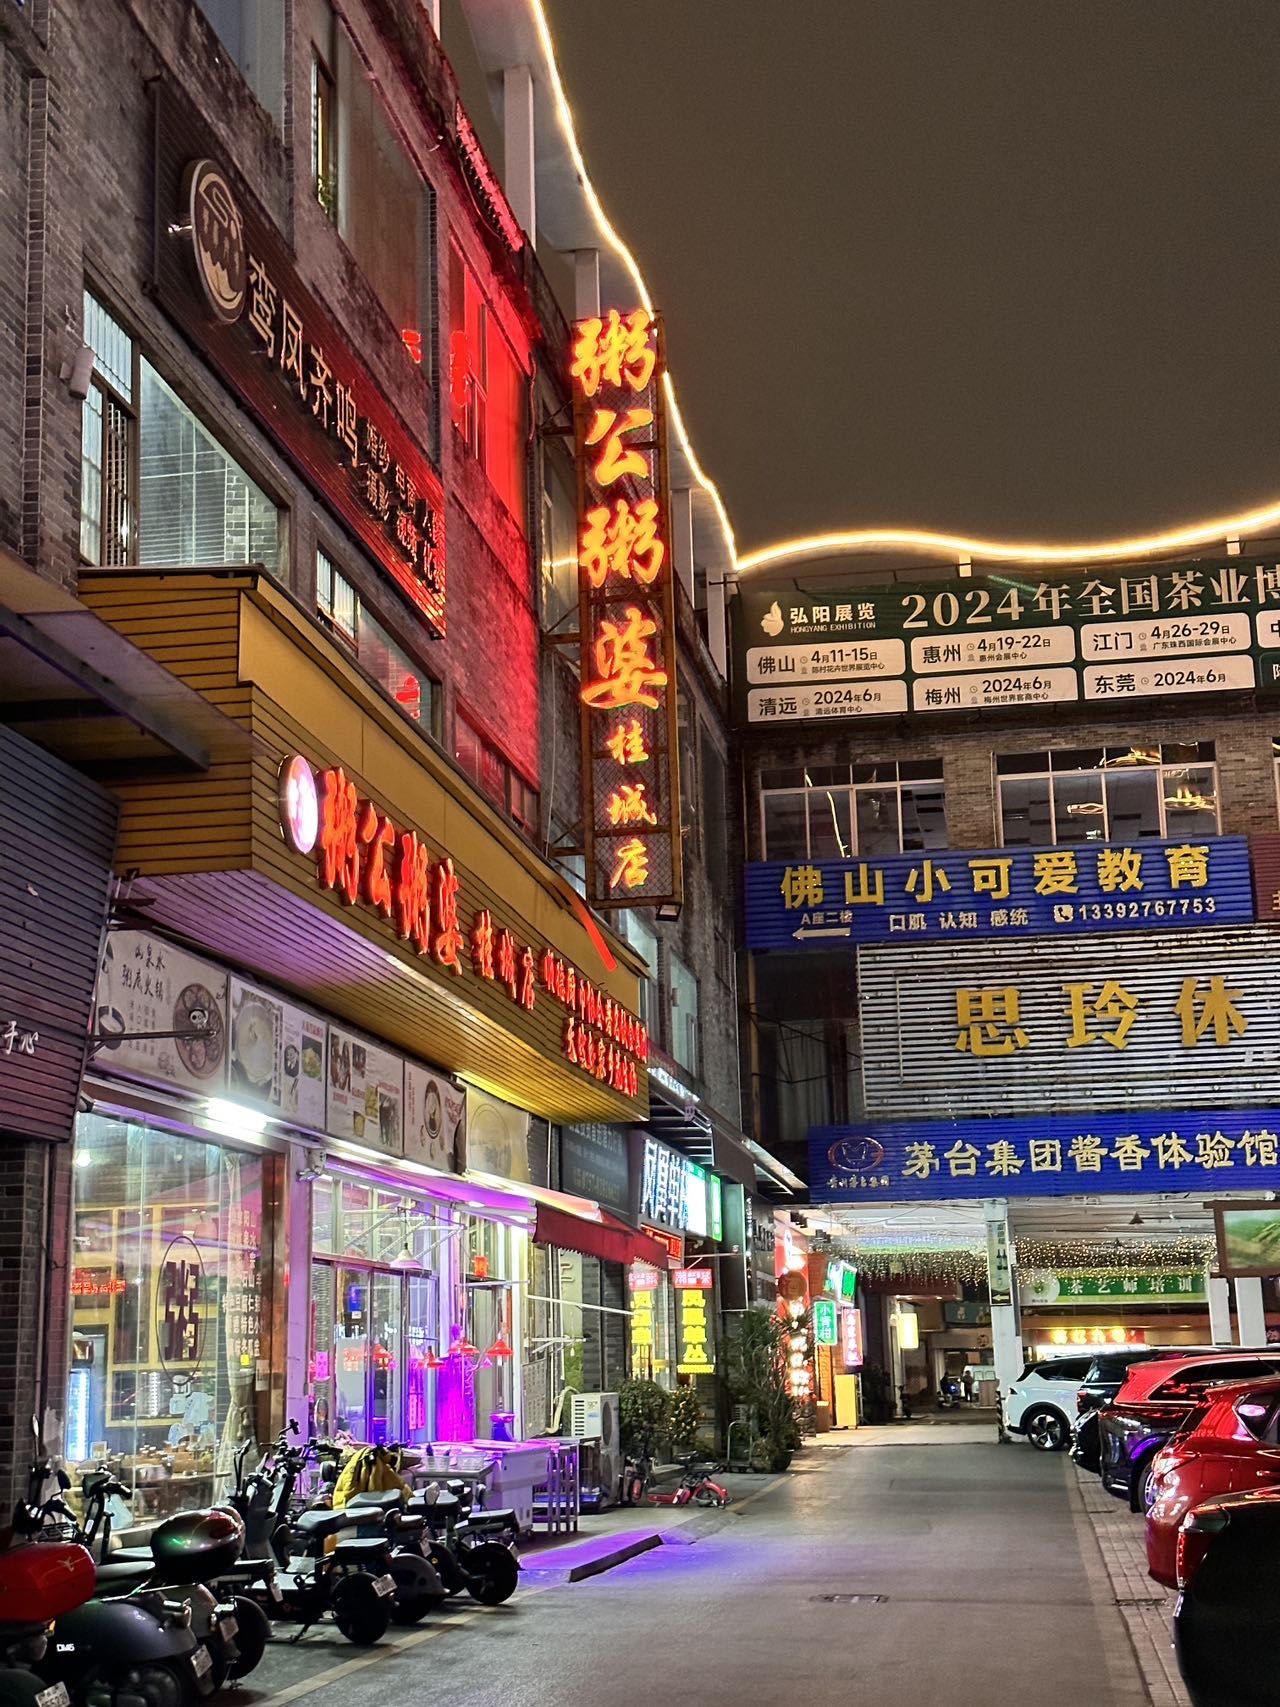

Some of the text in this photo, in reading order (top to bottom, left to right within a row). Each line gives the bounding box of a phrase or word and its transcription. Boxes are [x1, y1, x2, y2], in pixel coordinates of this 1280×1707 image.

[249, 255, 358, 468] 鸾凤齐鸣
[367, 422, 390, 473] 婚纱
[367, 467, 390, 521] 摄影
[571, 309, 668, 889] 粥公粥婆 桂城店
[790, 603, 876, 624] 弘阳展览
[790, 621, 876, 634] HONGYANG EXHIBITION
[1092, 621, 1230, 651] 江门 4月26-29日
[922, 635, 1051, 664] 惠州 4月19-22日
[1153, 636, 1237, 650] 广东珠西国际会展中心
[758, 648, 878, 674] 佛山 4月11-15日
[811, 663, 885, 674] 陈村花卉世界展览中心
[979, 652, 1027, 662] 惠州会展中心
[925, 676, 1052, 706] 梅州 2024年6月
[1094, 669, 1226, 693] 东莞 2024年6月
[759, 689, 881, 716] 清远 2024年6月
[815, 706, 862, 715] 清远体育中心
[984, 692, 1049, 704] 梅州世界客商中心
[318, 767, 464, 976] 粥公粥婆
[780, 844, 1210, 909] 佛山小可爱教育
[889, 909, 1029, 932] 口肌 认知 感统
[1079, 898, 1217, 920] 13392767753
[954, 975, 1249, 1057] 思玲休
[904, 1129, 1278, 1179] 茅台集团酱香体验馆
[1070, 1276, 1193, 1294] 茶艺师培训
